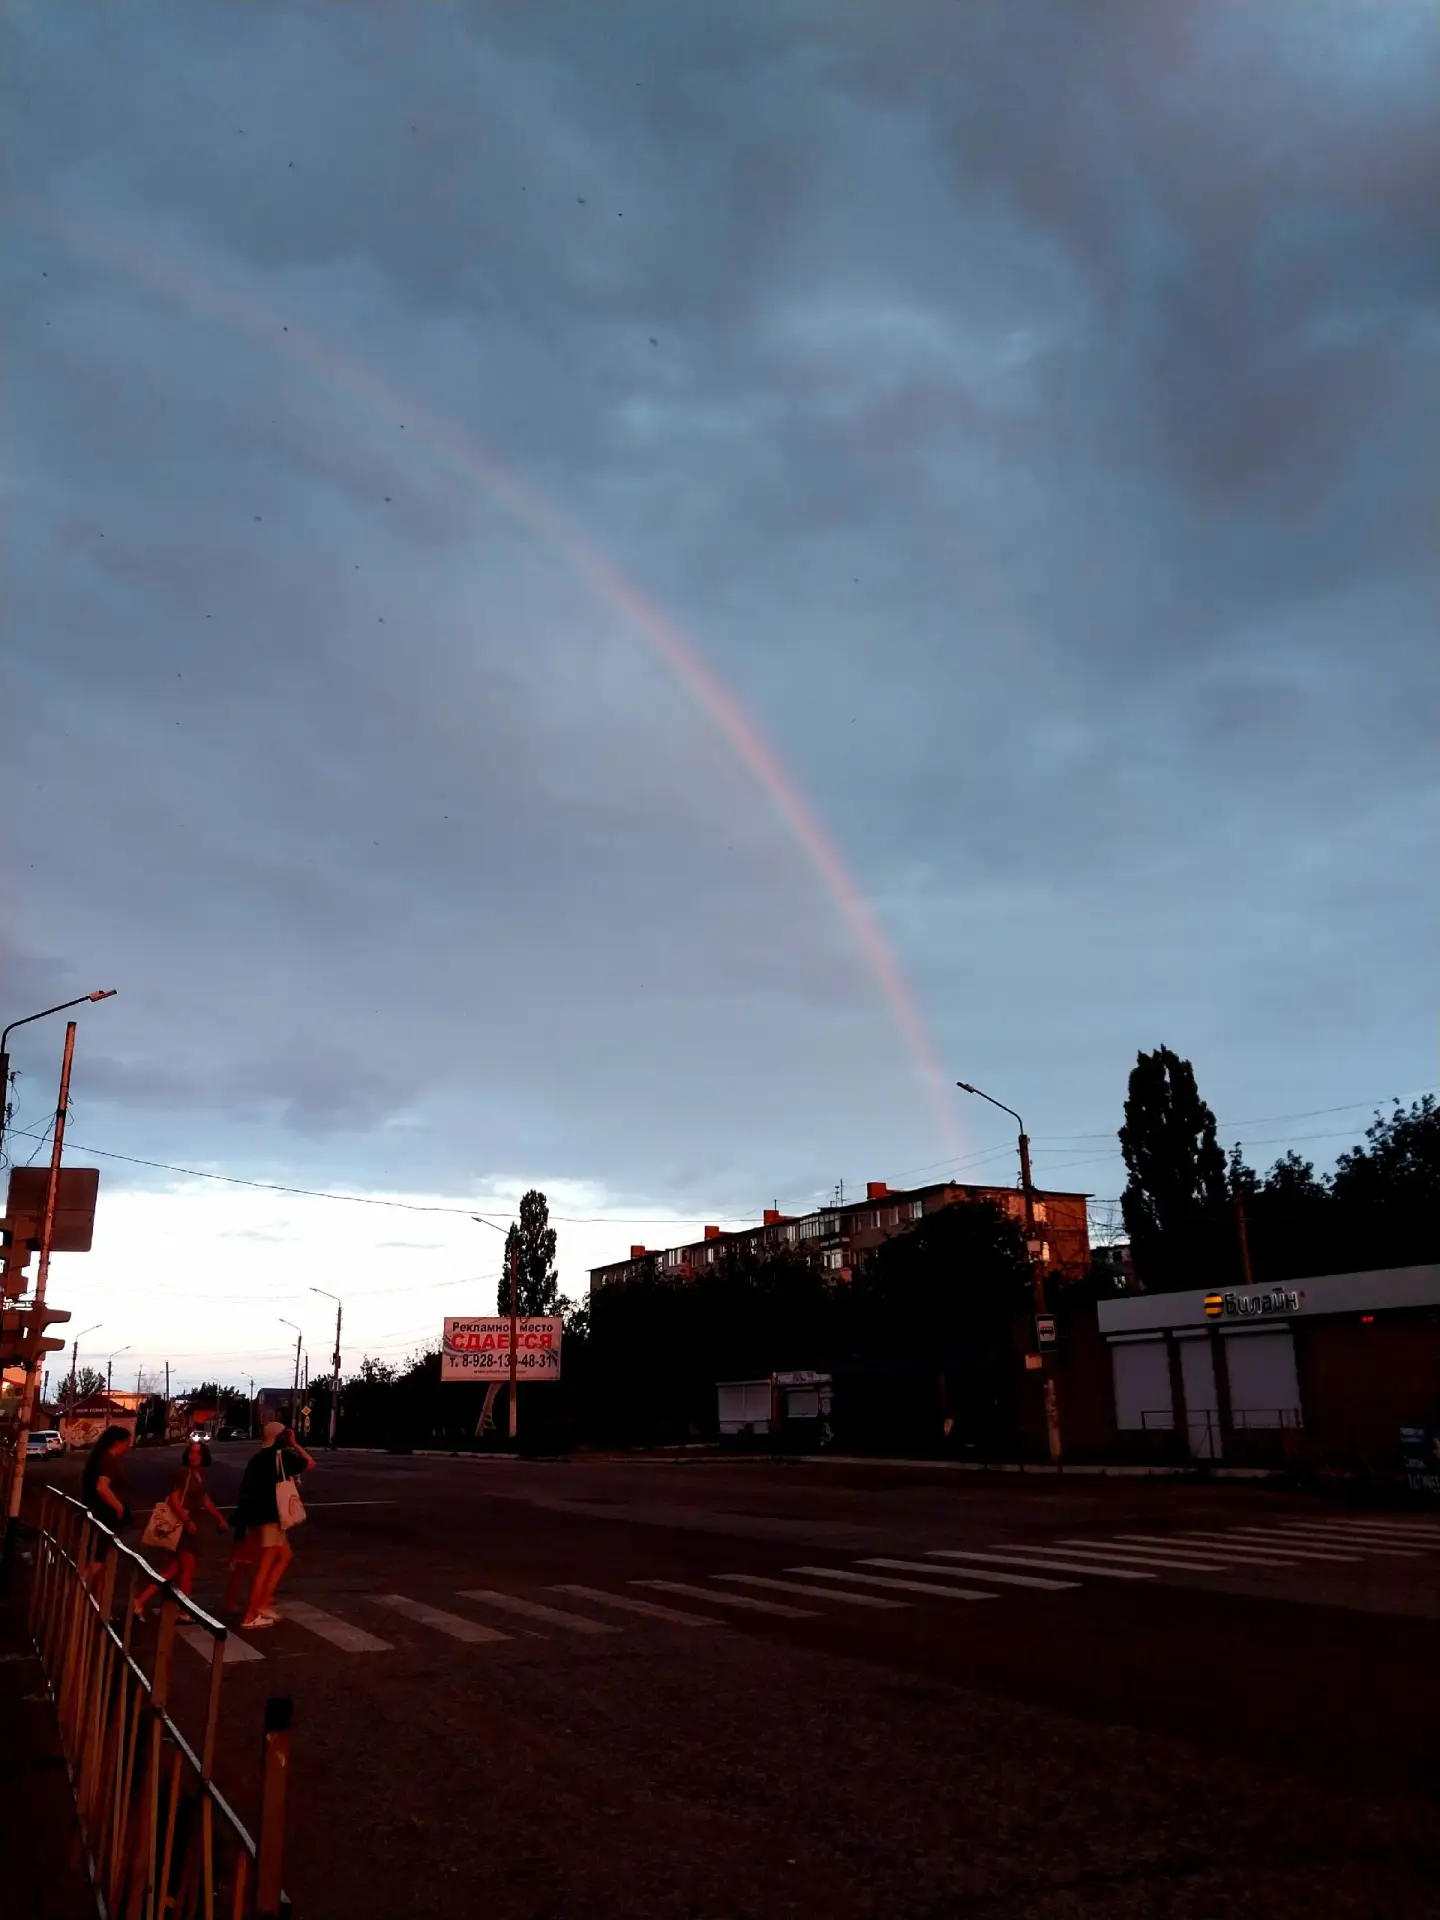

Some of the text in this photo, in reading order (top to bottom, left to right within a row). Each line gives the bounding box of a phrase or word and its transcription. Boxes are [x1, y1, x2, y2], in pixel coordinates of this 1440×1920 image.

[1224, 1287, 1299, 1315] Билайн
[452, 1322, 512, 1332] Рекламно
[462, 1354, 552, 1367] 8-928-13-48-31
